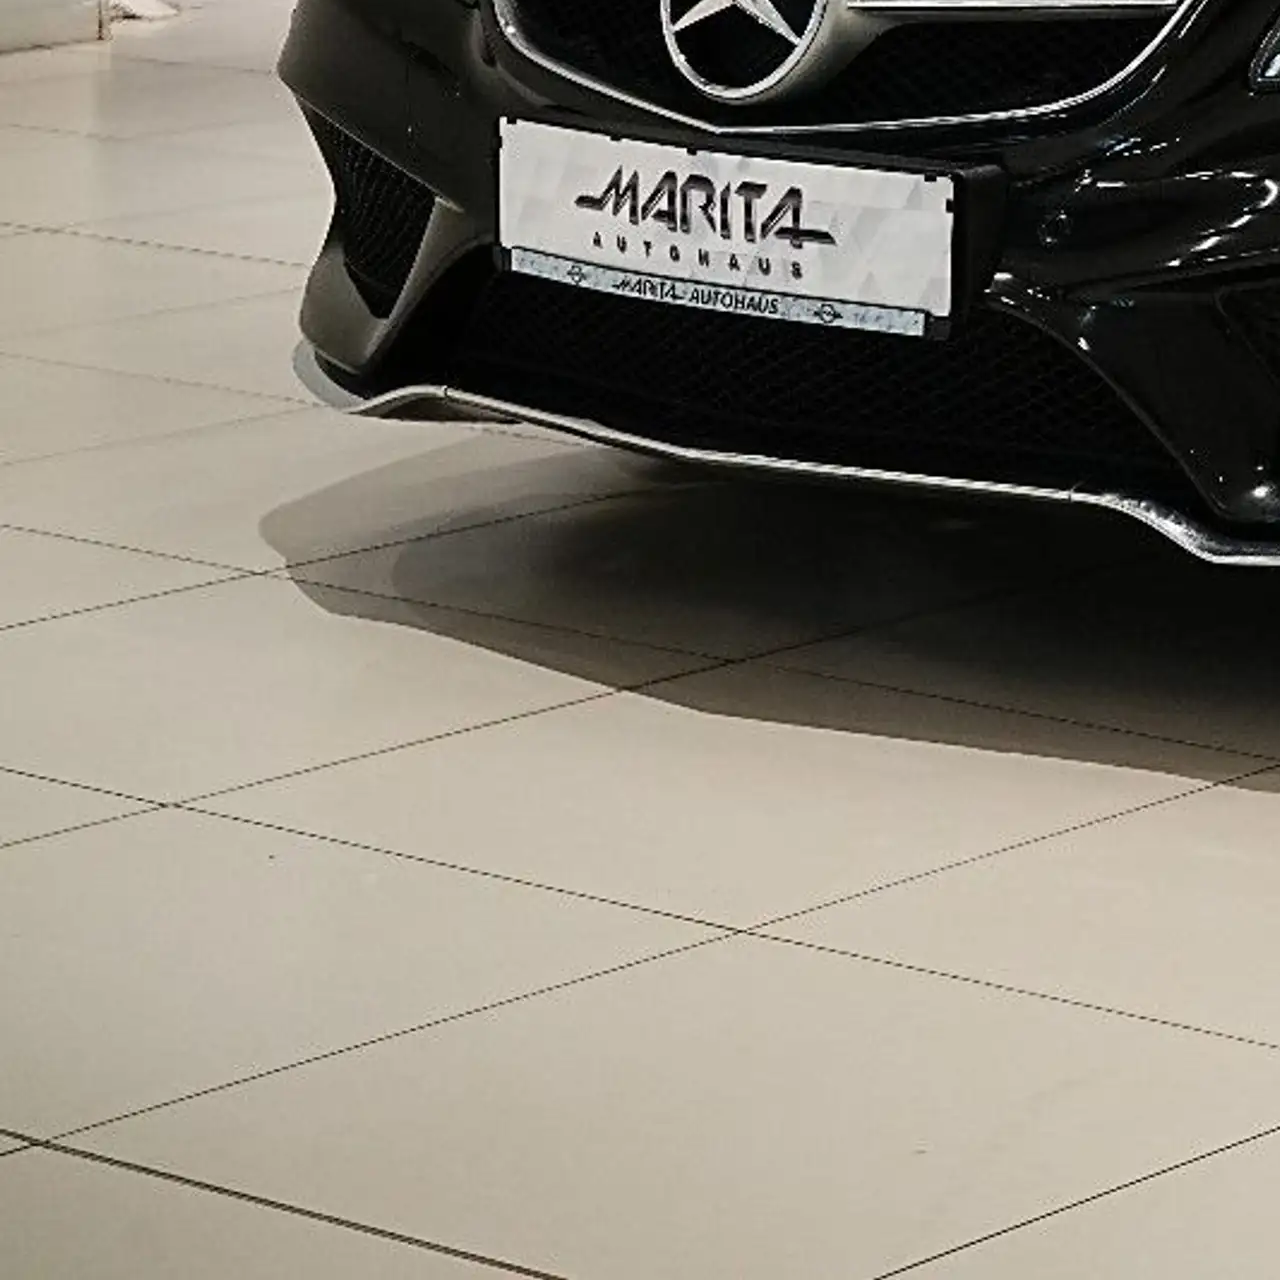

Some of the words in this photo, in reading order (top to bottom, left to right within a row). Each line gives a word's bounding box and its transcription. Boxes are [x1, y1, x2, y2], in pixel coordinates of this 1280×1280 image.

[574, 164, 836, 250] MARITA
[592, 230, 804, 280] AUTOHAUS
[611, 276, 684, 301] MARITA
[688, 287, 779, 315] AUTOHAUS
